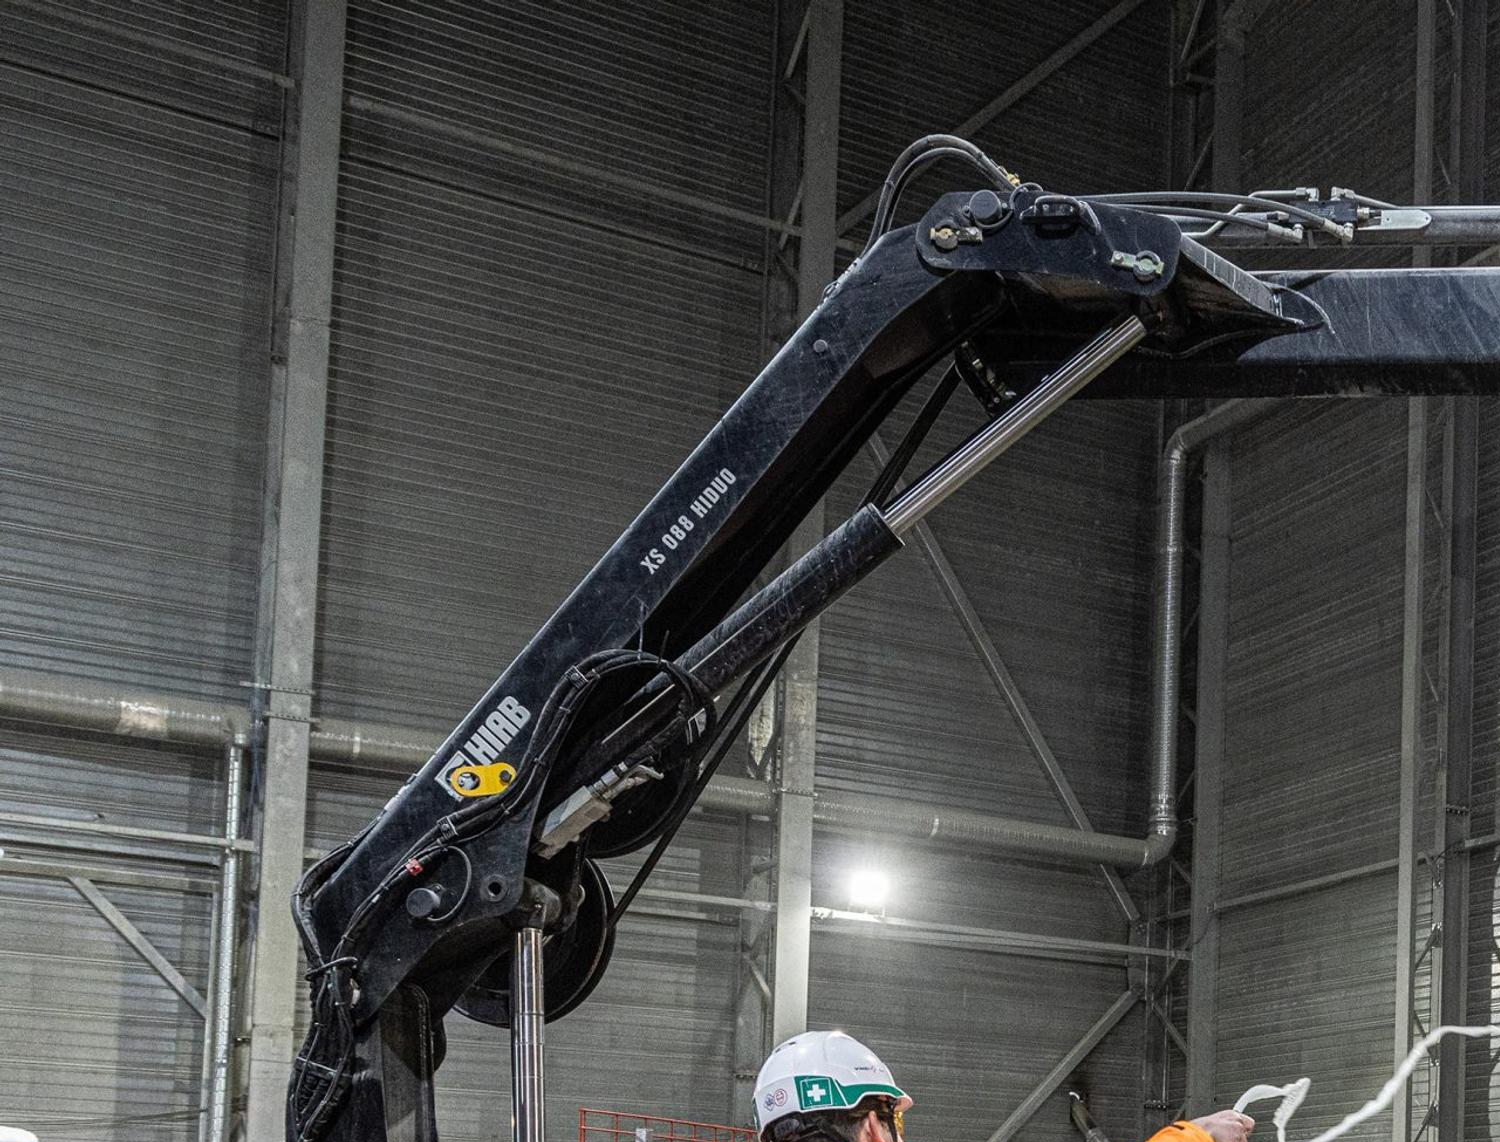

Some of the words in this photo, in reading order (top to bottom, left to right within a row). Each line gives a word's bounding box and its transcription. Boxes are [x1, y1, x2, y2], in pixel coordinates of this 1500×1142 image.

[640, 548, 666, 574] XS
[661, 515, 695, 550] 088
[689, 467, 737, 519] HIDUO
[464, 695, 532, 765] HIAB
